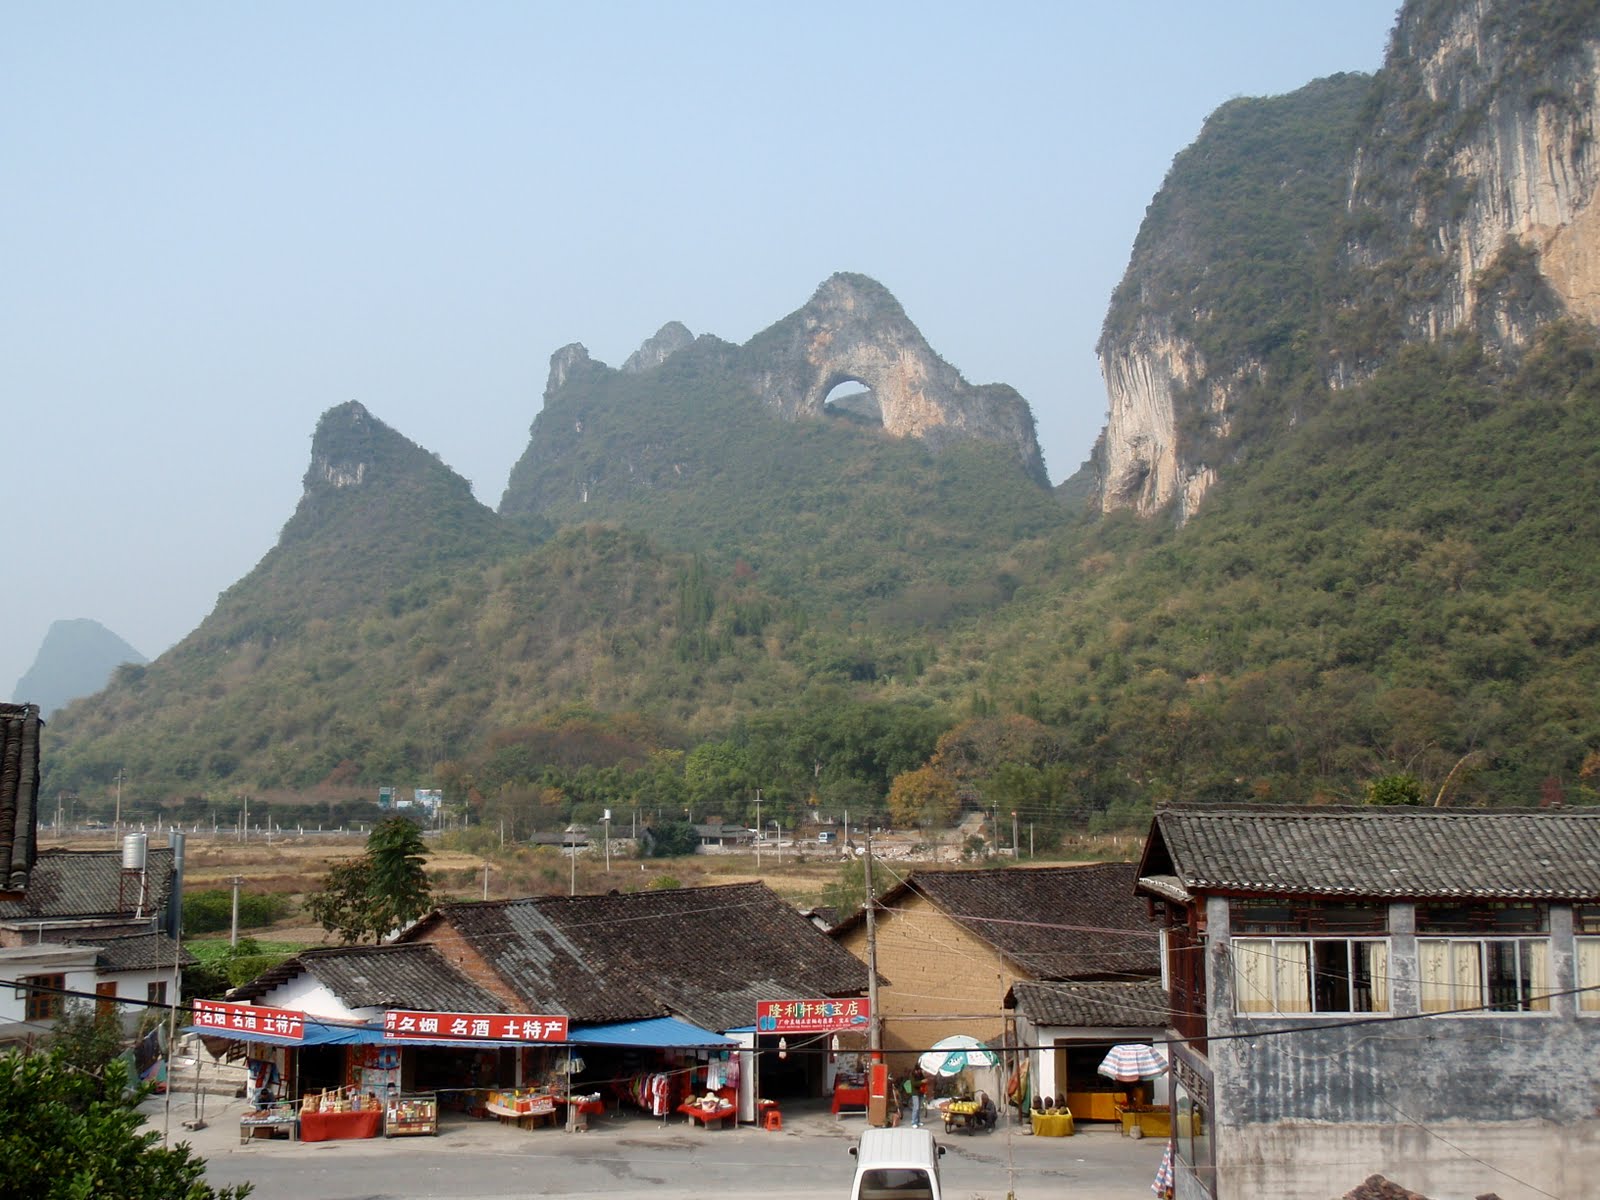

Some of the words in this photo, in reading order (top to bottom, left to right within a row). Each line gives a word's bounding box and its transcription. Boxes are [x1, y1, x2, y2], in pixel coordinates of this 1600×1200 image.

[202, 1005, 226, 1025] 名烟
[233, 1008, 256, 1029] 名酒
[263, 1012, 302, 1034] 土特产
[768, 1001, 859, 1018] 隆利轩珠宝店
[398, 1016, 439, 1034] 名烟
[450, 1018, 490, 1037] 名酒
[501, 1020, 563, 1039] 土特产
